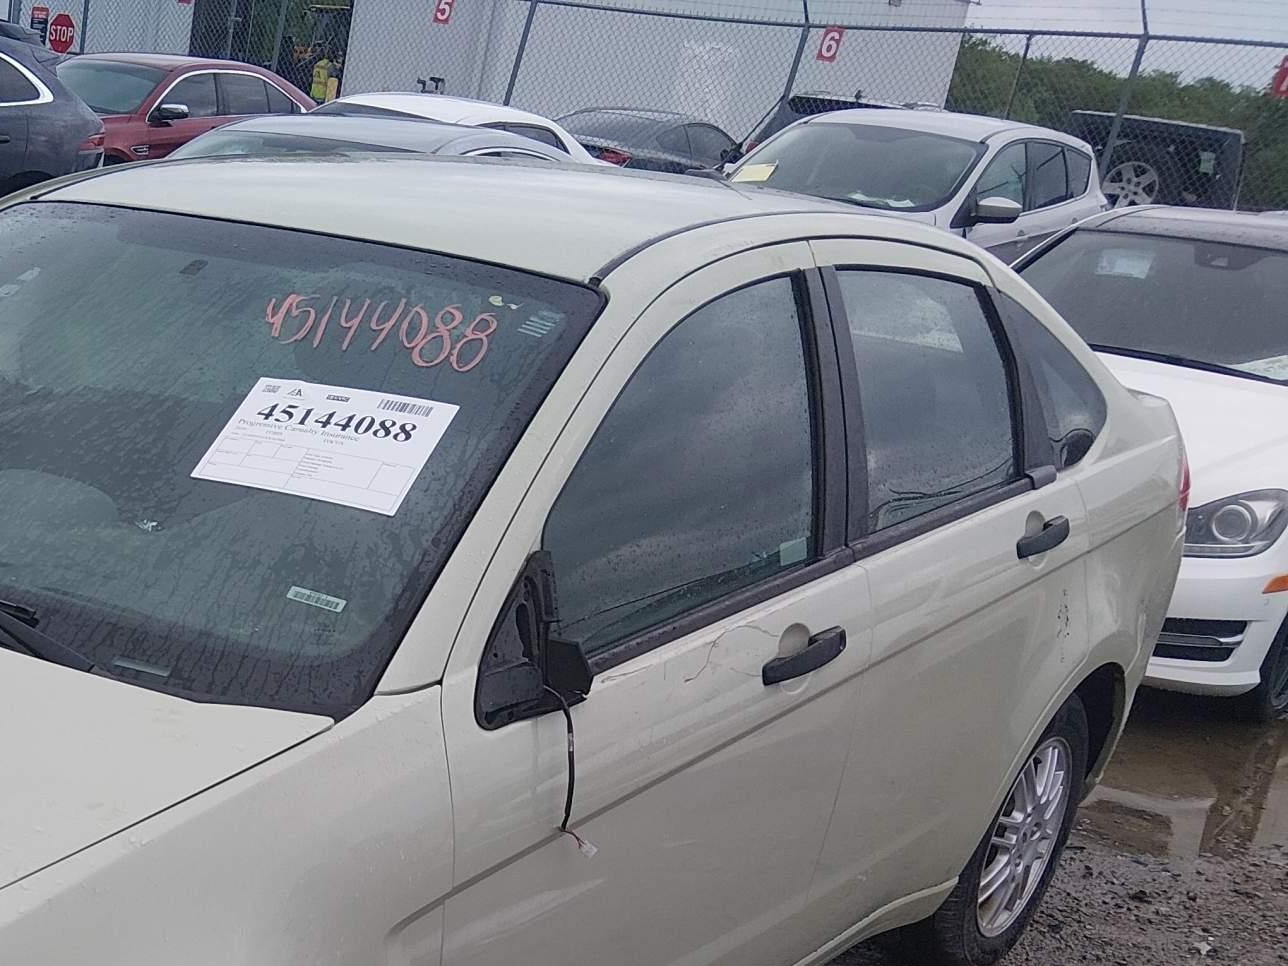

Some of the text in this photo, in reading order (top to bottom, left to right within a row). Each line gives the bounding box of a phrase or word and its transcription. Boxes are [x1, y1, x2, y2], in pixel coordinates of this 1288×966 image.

[436, 0, 452, 20] 5
[49, 25, 74, 42] STOP
[821, 31, 840, 57] 6
[265, 294, 498, 372] 45144088
[238, 418, 282, 431] Progressive
[320, 430, 360, 442] Insurance
[257, 403, 418, 444] 45144088
